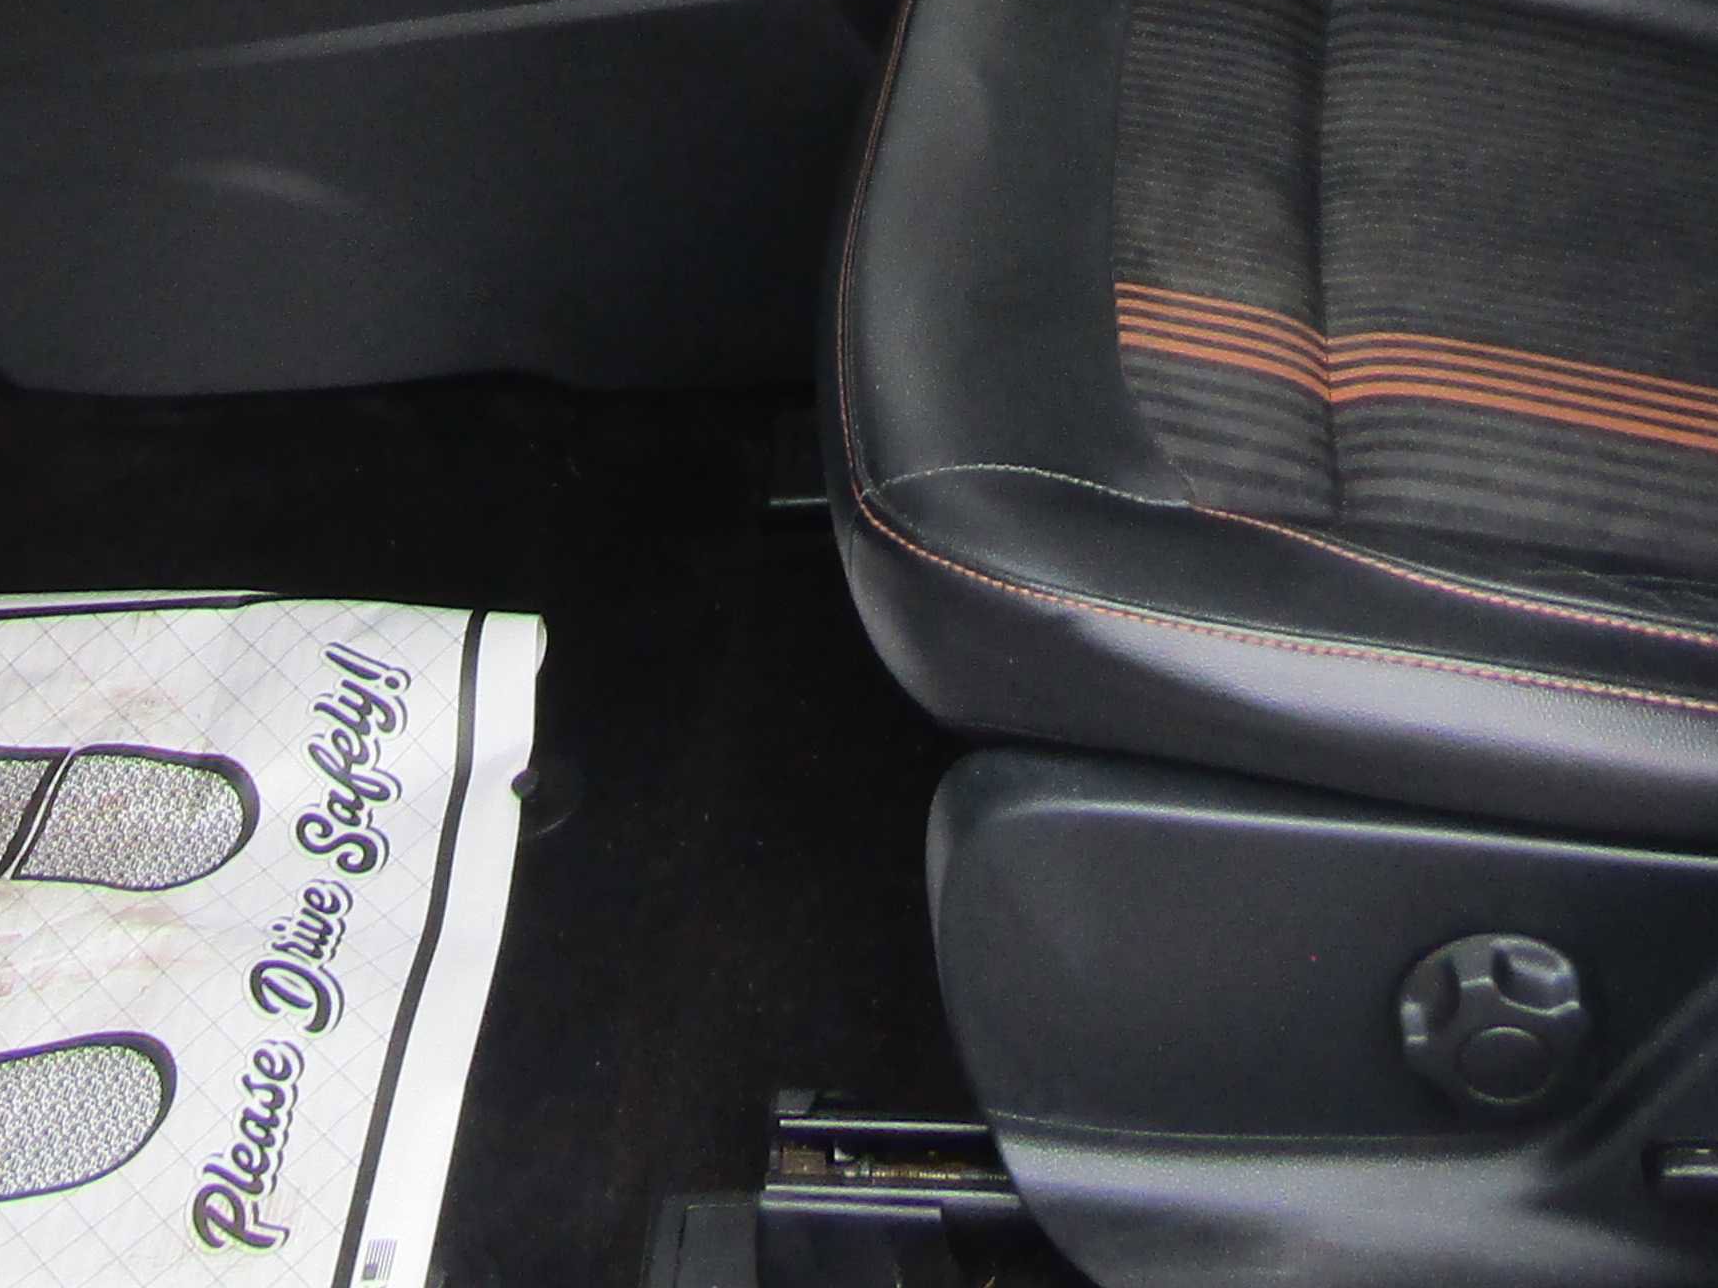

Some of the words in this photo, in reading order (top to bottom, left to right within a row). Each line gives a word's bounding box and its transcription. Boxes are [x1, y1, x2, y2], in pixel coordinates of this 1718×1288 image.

[295, 644, 407, 874] Safely!
[249, 881, 349, 1034] Drive
[192, 1041, 301, 1250] Please
